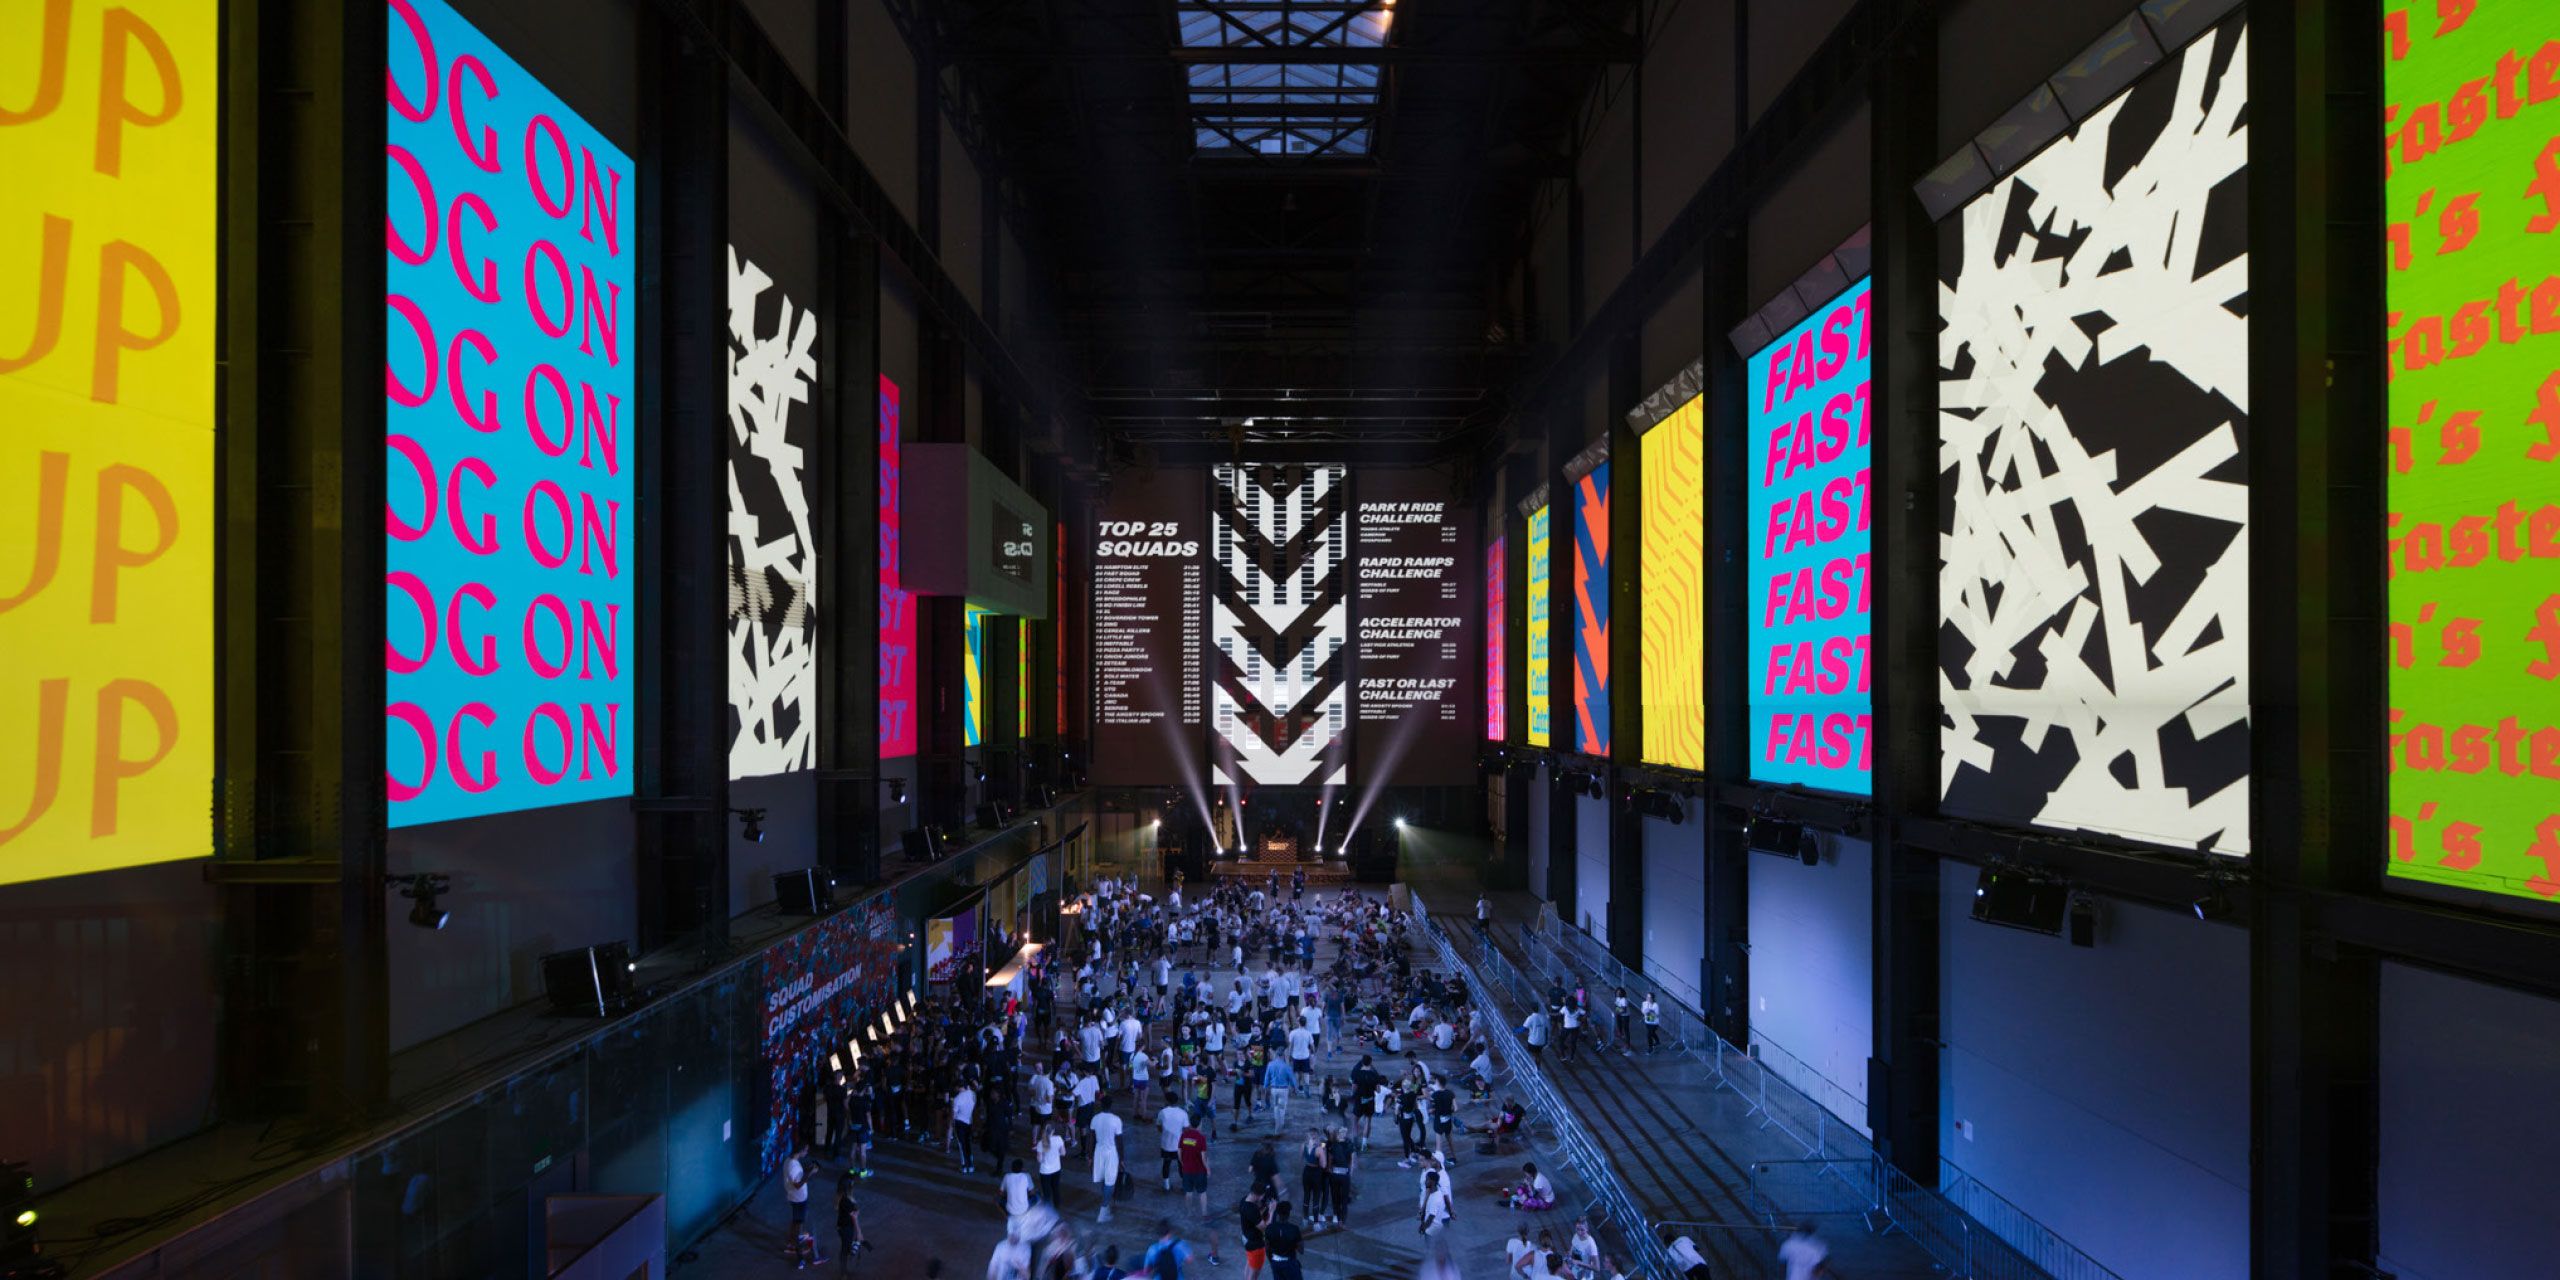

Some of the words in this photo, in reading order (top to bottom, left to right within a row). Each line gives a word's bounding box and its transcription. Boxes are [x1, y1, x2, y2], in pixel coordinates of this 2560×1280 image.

[525, 114, 620, 257] ON
[525, 240, 620, 367] ON
[525, 364, 620, 476] ON
[1359, 503, 1397, 512] PARK
[1399, 503, 1409, 512] N
[1411, 503, 1444, 512] RIDE
[1360, 514, 1443, 523] CHALLENGE
[524, 480, 619, 579] ON
[1099, 521, 1146, 536] TOP
[1148, 522, 1179, 536] 25
[1096, 541, 1199, 558] SQUADS
[1359, 558, 1402, 566] RAPID
[1403, 558, 1455, 566] RAMPS
[1360, 568, 1443, 578] CHALLENGE
[1359, 617, 1461, 627] ACCELERATOR
[524, 594, 619, 680] ON
[1360, 629, 1443, 639] CHALLENGE
[1359, 679, 1396, 688] FAST
[1396, 679, 1418, 688] OR
[1419, 679, 1457, 688] LAST
[1359, 691, 1442, 700] CHALLENGE
[524, 703, 619, 785] ON
[768, 962, 862, 1037] CUSTOMISATION
[769, 972, 814, 1012] SQUAD
